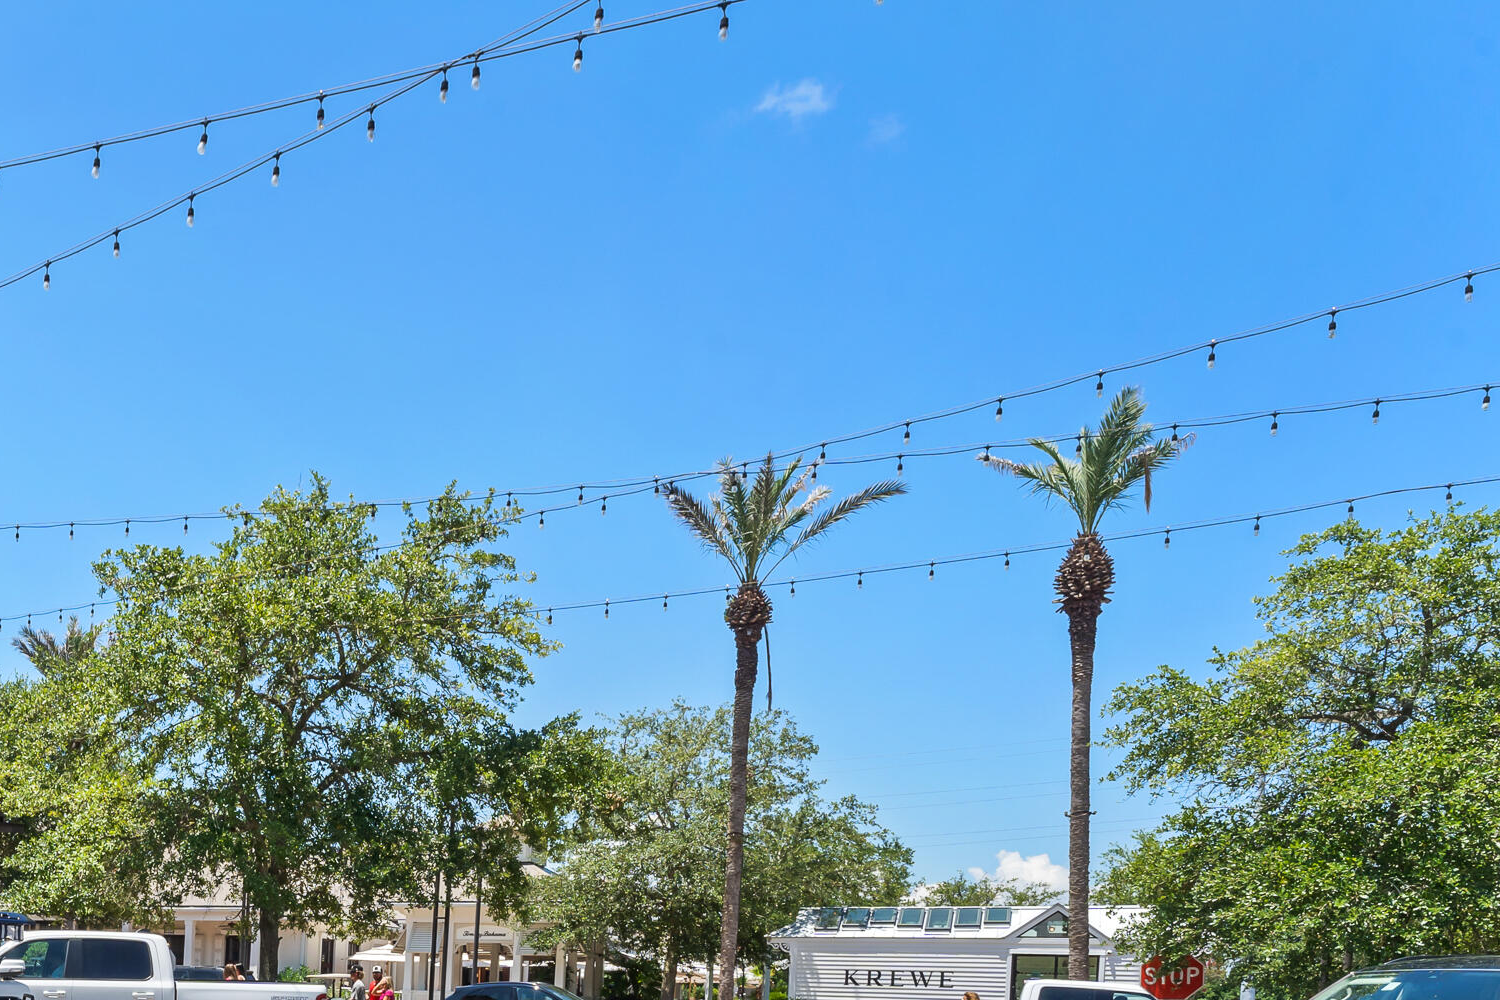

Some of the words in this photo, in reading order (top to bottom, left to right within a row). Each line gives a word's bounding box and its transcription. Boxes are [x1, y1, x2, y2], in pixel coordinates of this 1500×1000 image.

[463, 930, 483, 938] Tomy
[844, 969, 955, 989] KREWE
[1144, 966, 1200, 986] SOP
